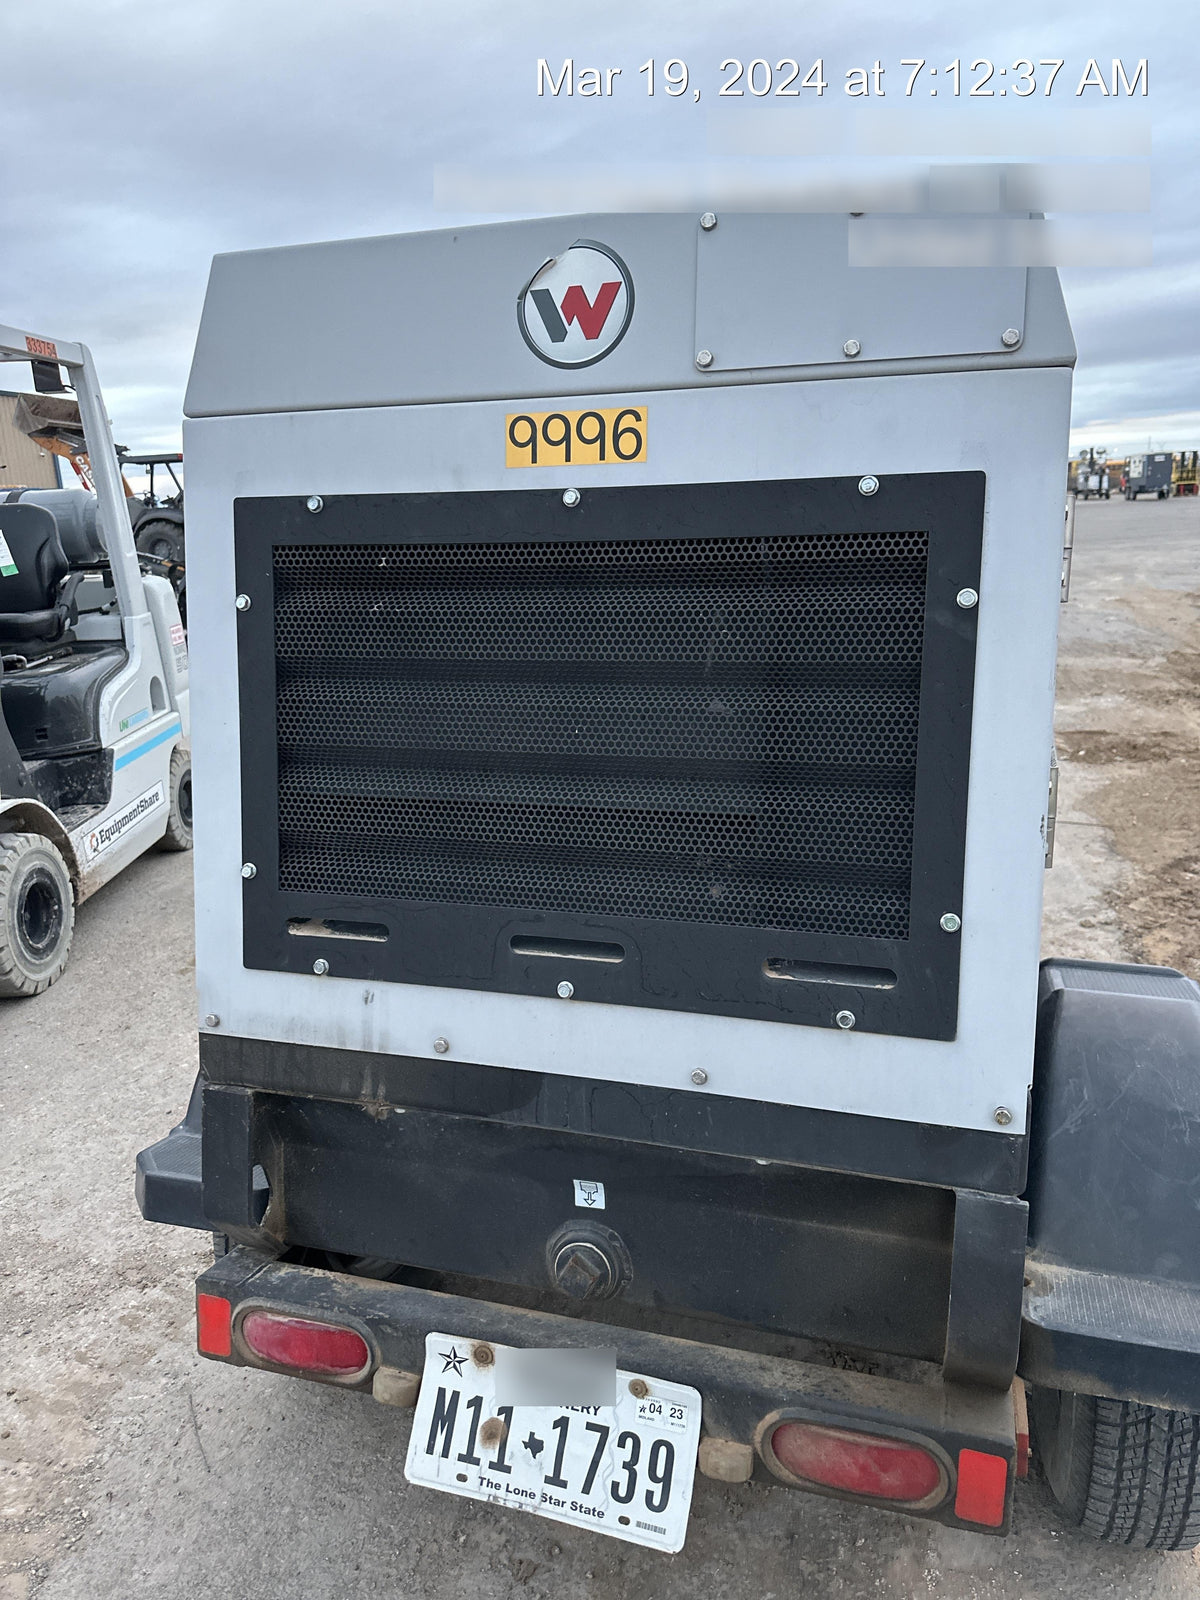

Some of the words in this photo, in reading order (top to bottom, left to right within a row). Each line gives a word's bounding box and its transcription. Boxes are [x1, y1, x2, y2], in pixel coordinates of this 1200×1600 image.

[509, 409, 643, 464] 9996
[99, 791, 160, 844] EquipmentShare
[649, 1403, 662, 1415] 04
[670, 1407, 683, 1420] 23
[544, 1415, 675, 1513] 1739
[478, 1476, 501, 1490] The
[506, 1483, 536, 1500] Lone
[541, 1492, 567, 1508] Star
[570, 1501, 605, 1518] State
